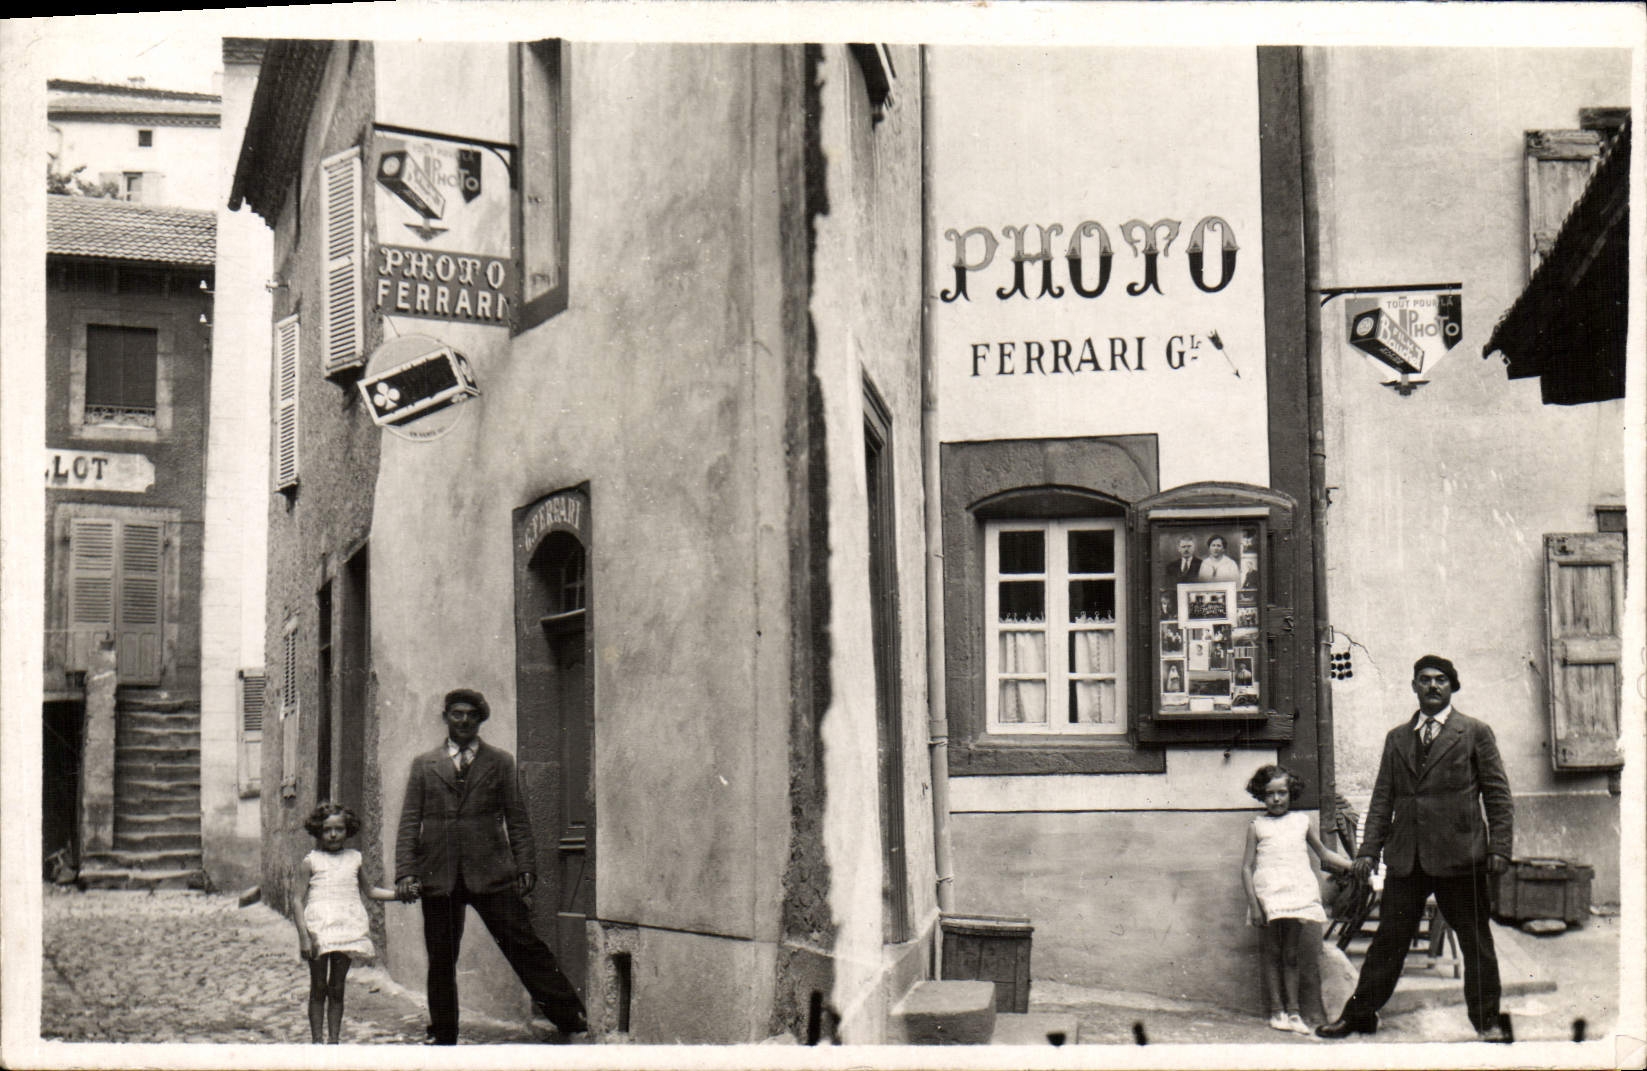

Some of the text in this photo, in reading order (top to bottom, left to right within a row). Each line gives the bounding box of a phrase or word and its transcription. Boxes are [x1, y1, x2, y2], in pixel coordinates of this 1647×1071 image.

[378, 247, 506, 289] PHOTO
[940, 216, 1240, 303] PHOTO
[376, 278, 505, 319] FERRARI
[1387, 300, 1410, 309] TOUT
[970, 336, 1147, 377] FERRARI
[45, 455, 108, 480] LOT
